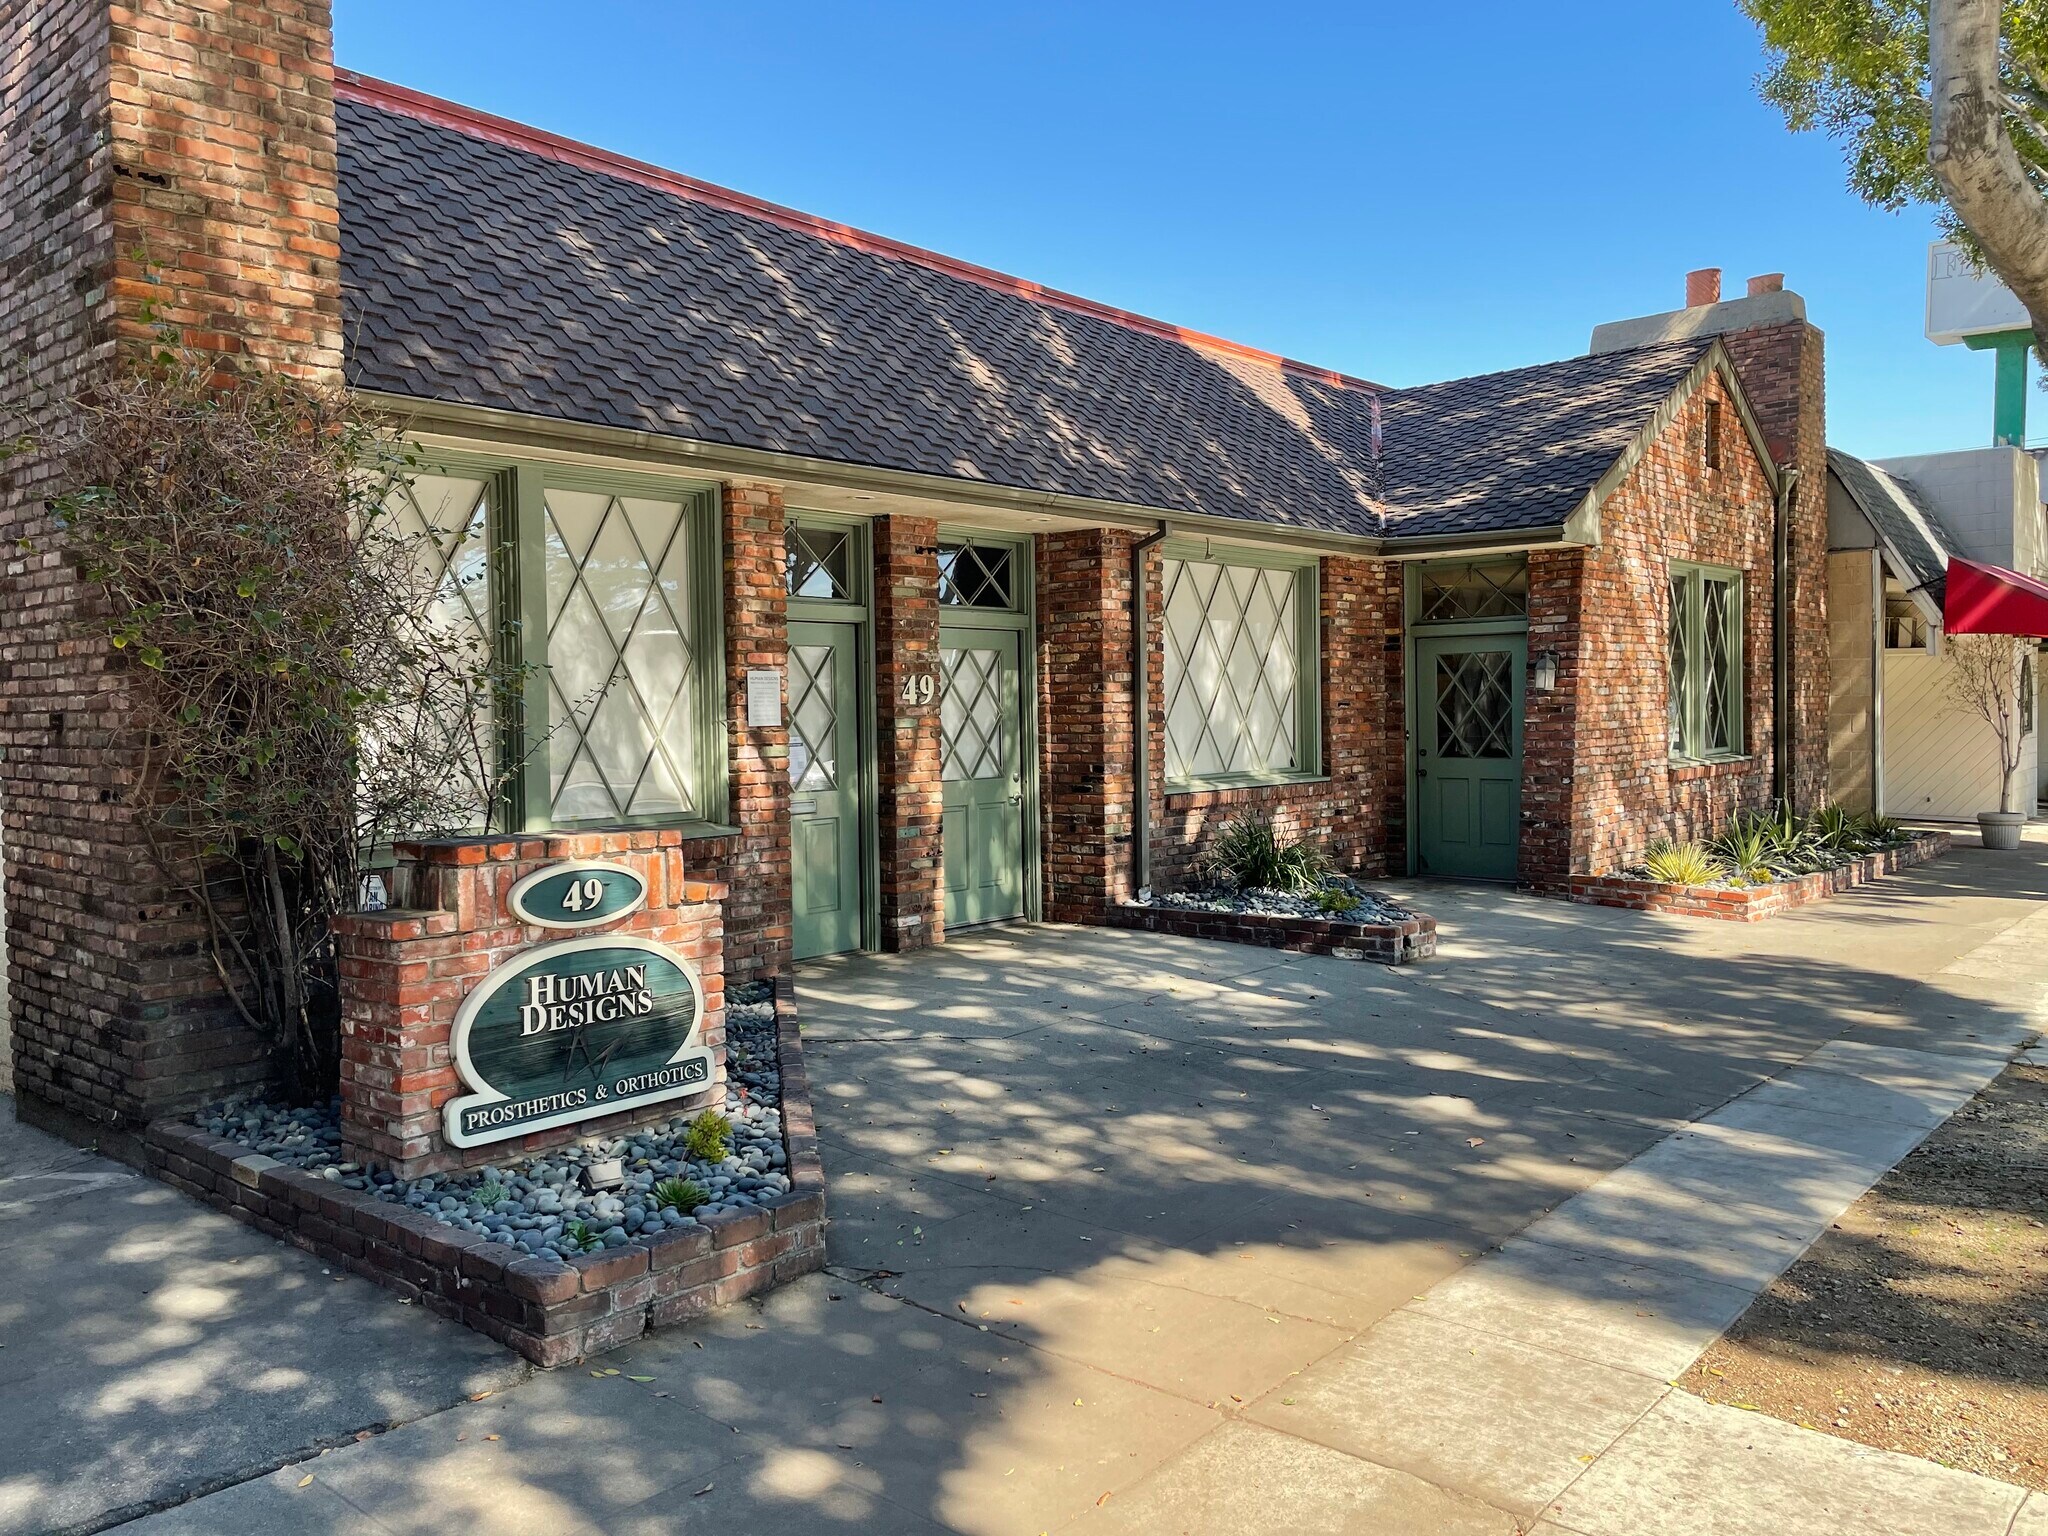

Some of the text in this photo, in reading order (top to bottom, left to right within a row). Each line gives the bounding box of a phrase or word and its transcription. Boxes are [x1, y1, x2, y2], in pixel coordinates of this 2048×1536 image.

[902, 675, 934, 705] 49
[562, 878, 604, 912] 49
[528, 964, 646, 1006] HUMAN
[519, 989, 653, 1037] DESIGNS
[466, 1062, 704, 1131] PROSTHETICS & ORTHOTICS
